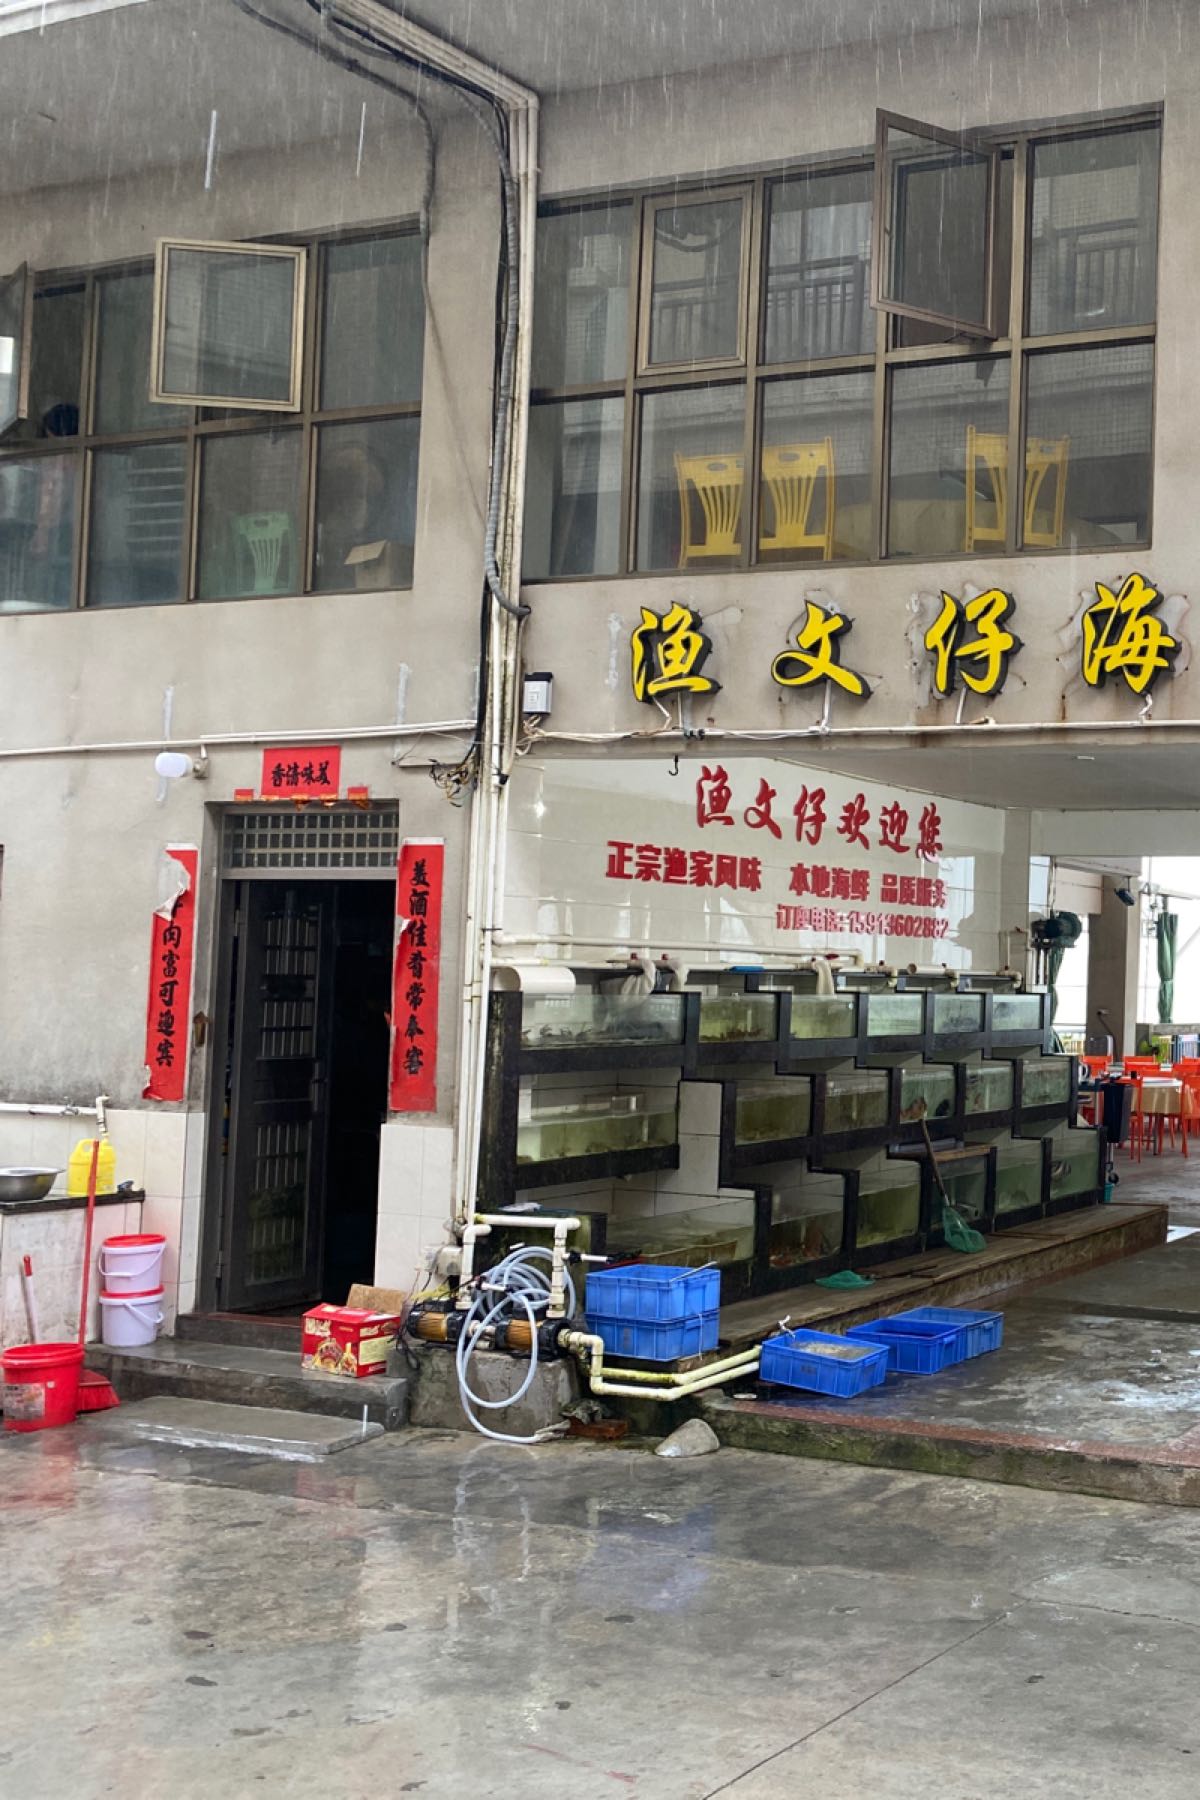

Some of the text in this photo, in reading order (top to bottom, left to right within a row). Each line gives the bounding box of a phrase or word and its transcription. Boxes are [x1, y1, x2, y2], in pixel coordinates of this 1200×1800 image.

[695, 765, 943, 863] 渔文仔欢迎您
[605, 840, 948, 908] 正宗渔家风味 本地海鲜 品质服务
